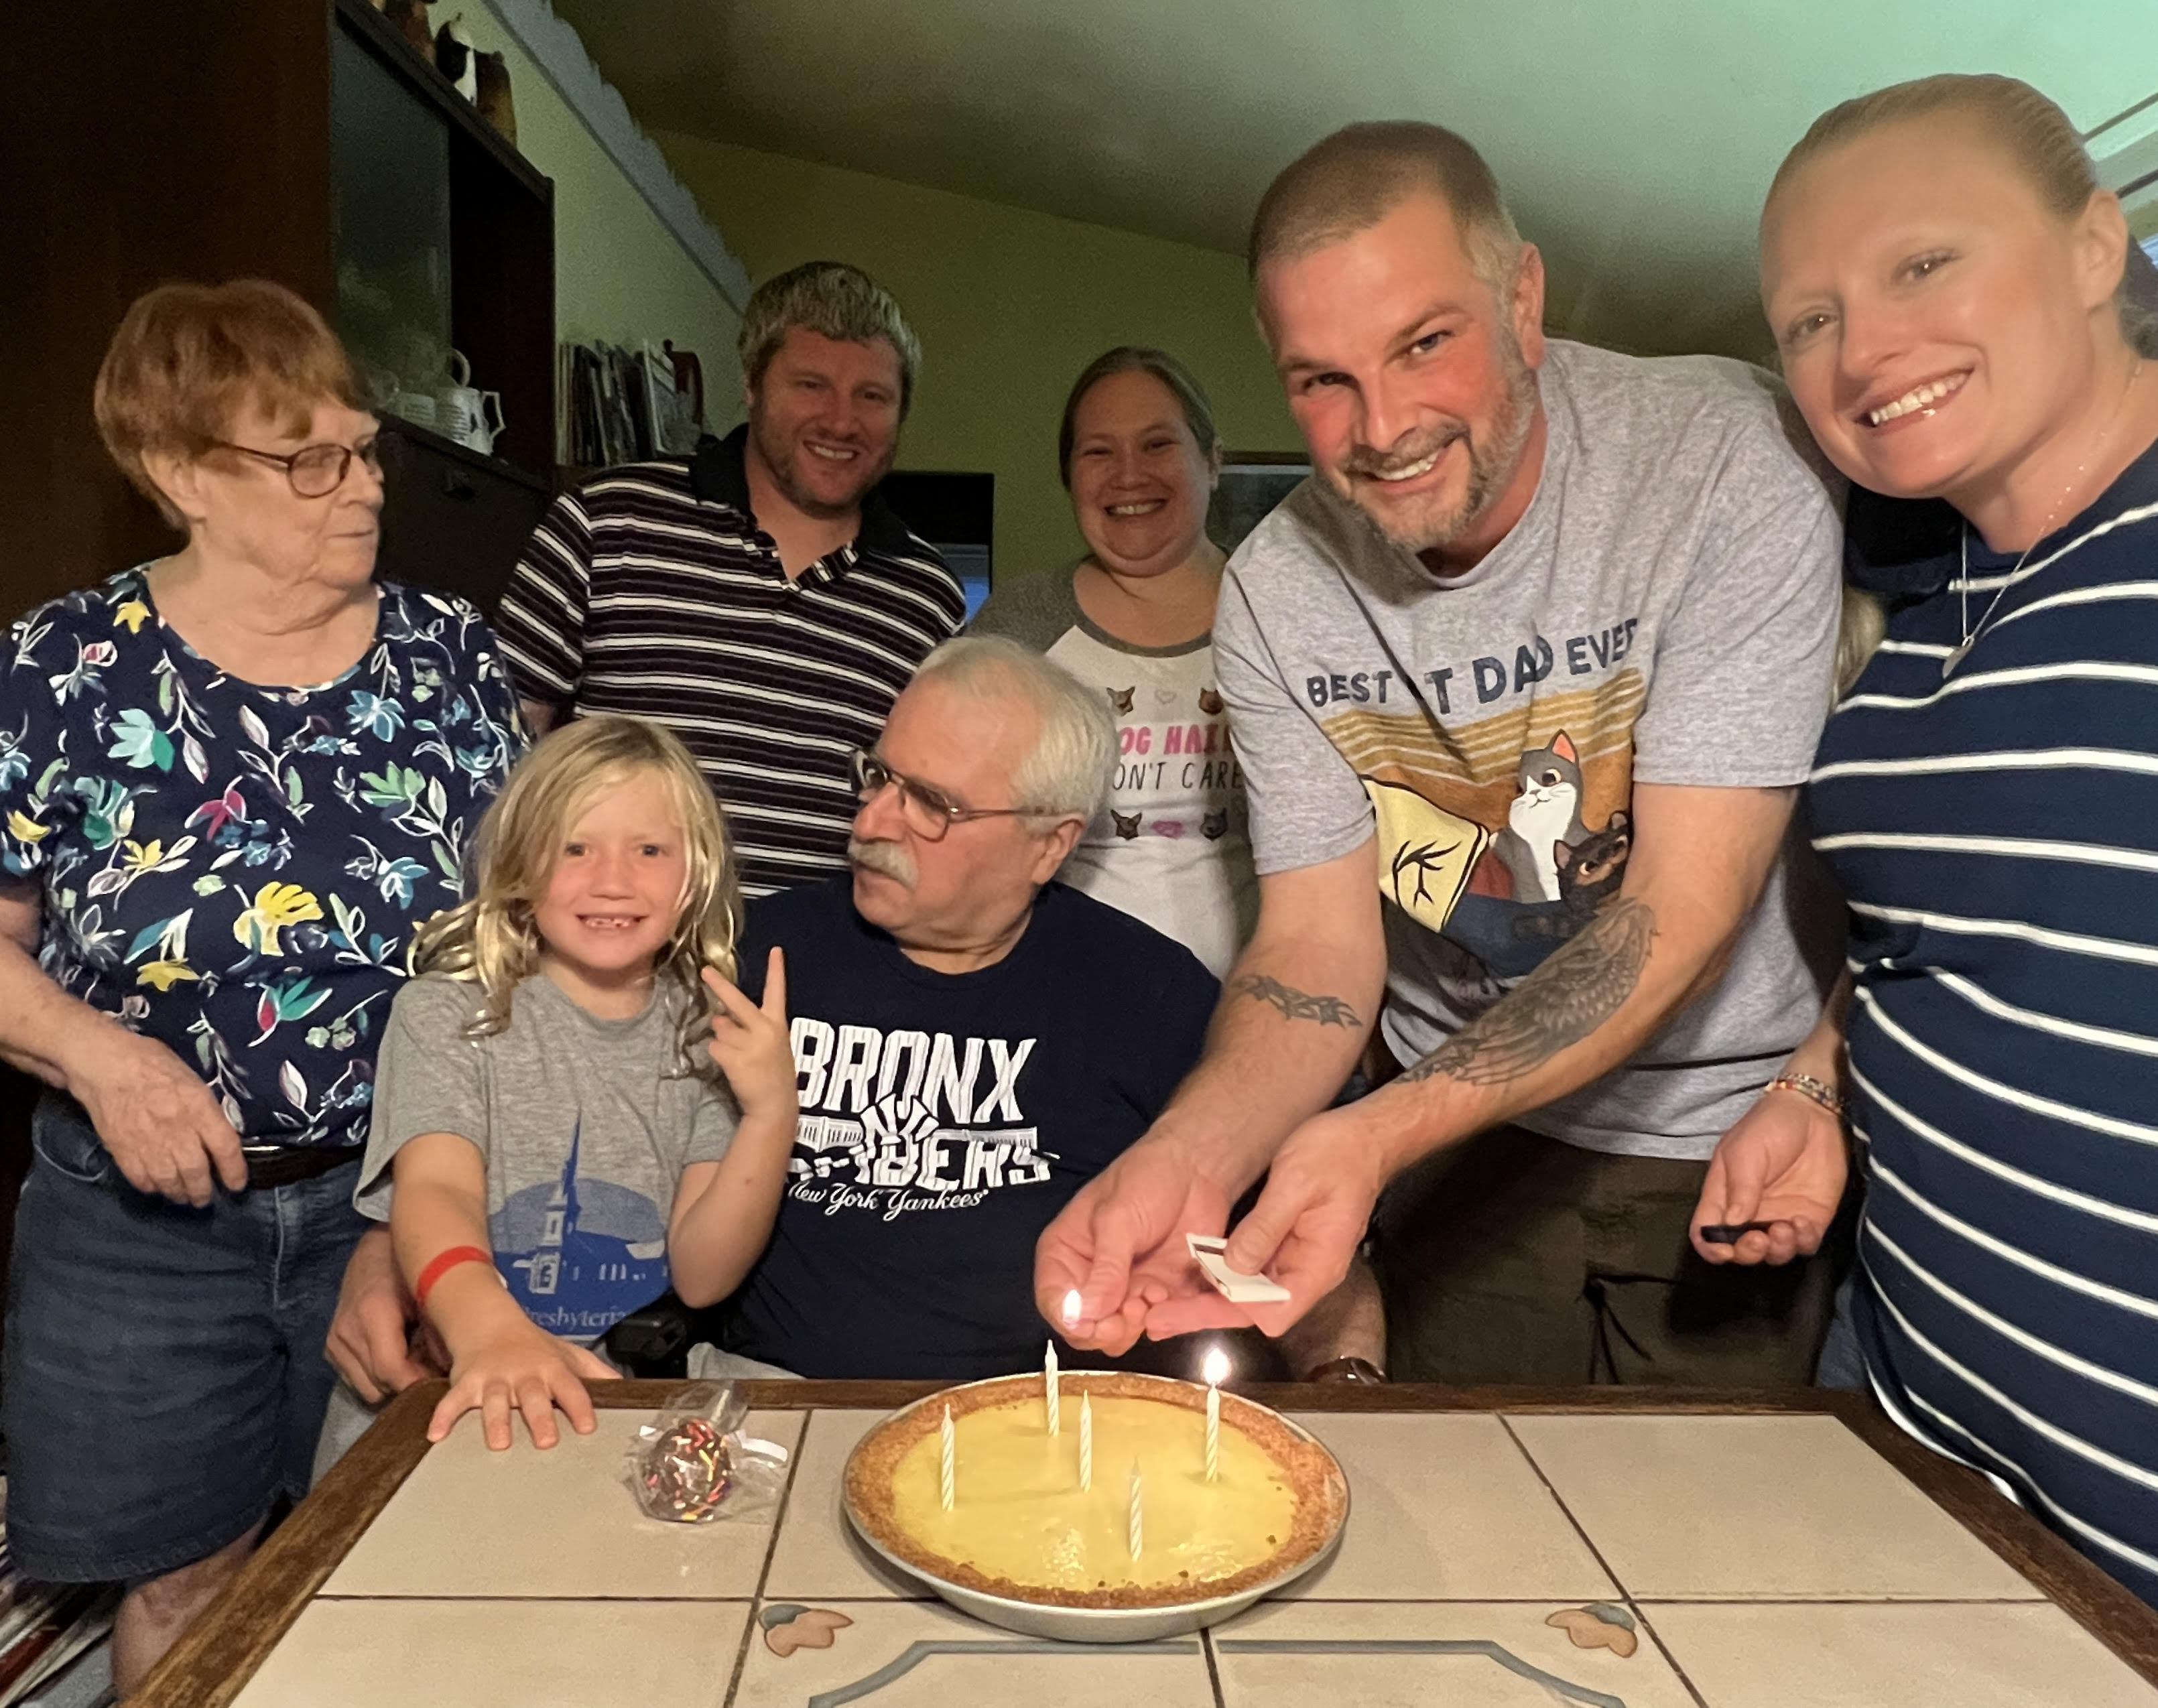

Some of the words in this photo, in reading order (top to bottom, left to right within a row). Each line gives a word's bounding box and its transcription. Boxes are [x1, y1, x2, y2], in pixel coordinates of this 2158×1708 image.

[1307, 671, 1392, 707] BEST
[1423, 667, 1454, 714] T
[1472, 635, 1553, 704] DAD
[1118, 726, 1151, 756] OG
[1113, 761, 1166, 791] ON'T
[1182, 761, 1244, 790] CARE
[790, 1017, 1037, 1124] BRONX
[824, 1183, 879, 1216] York
[883, 1189, 984, 1222] Yankees
